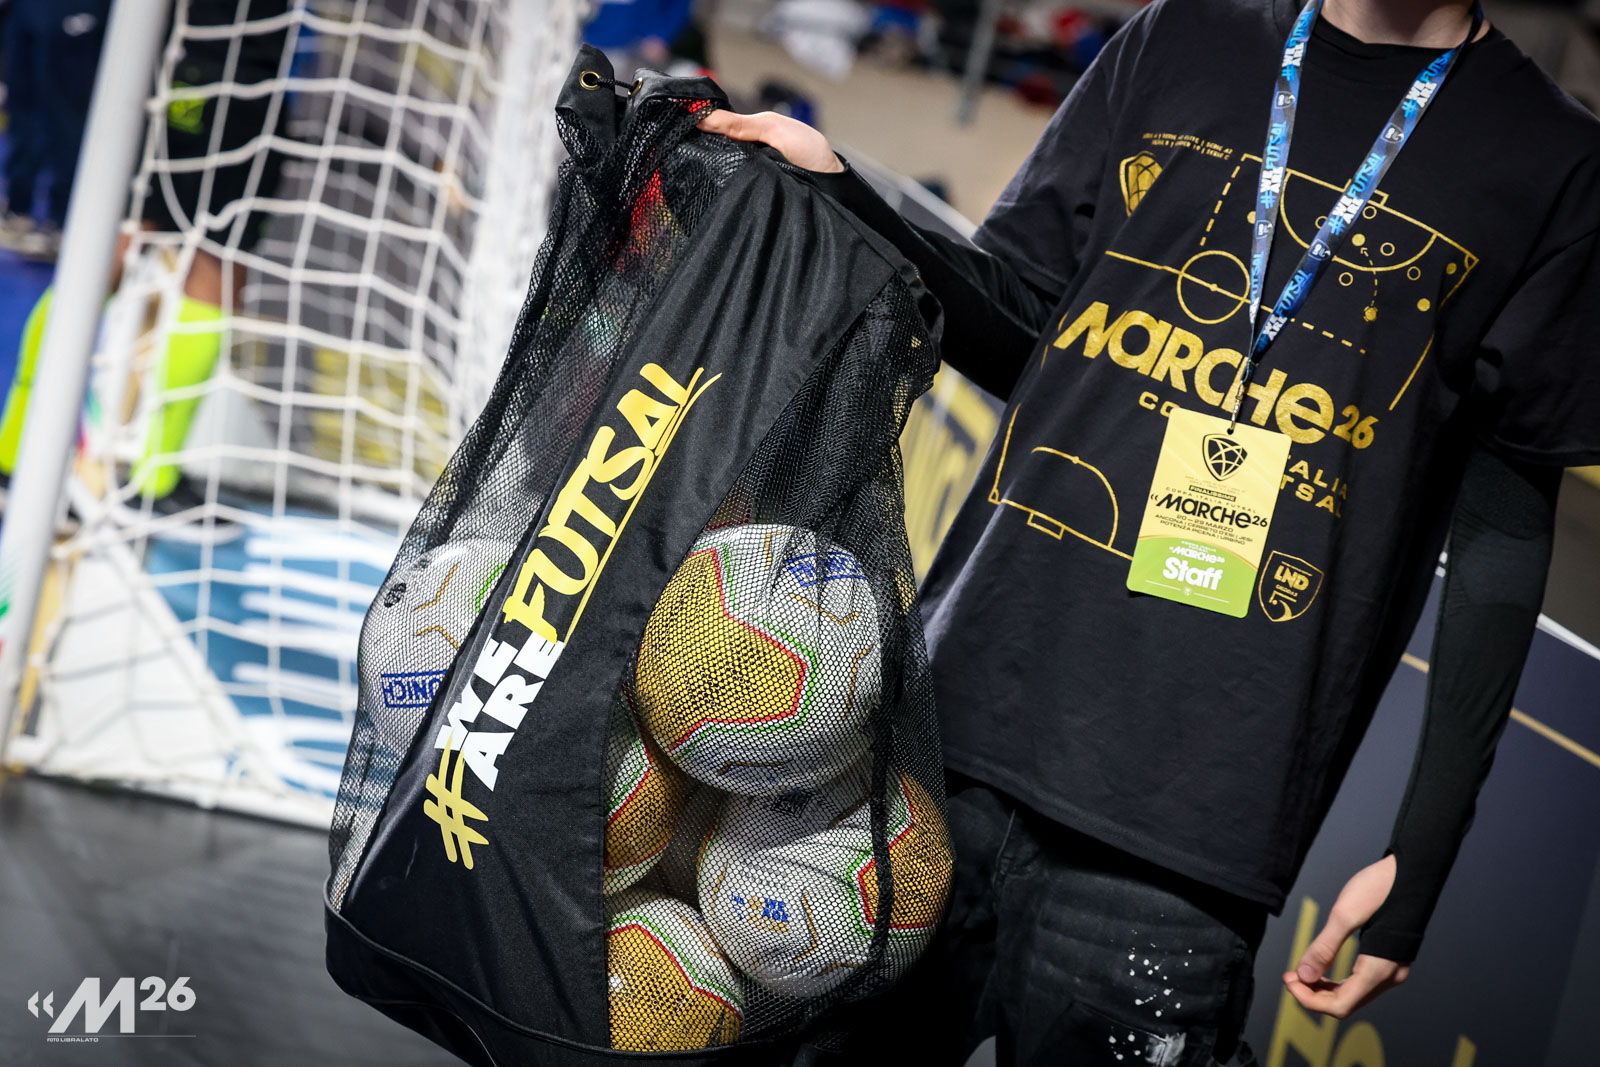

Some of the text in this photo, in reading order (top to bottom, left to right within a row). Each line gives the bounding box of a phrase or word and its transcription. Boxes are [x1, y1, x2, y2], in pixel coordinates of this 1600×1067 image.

[1347, 152, 1386, 200] FUTSAL
[1276, 269, 1312, 317] FUTSAL
[1280, 474, 1341, 518] TSAL
[1287, 454, 1347, 500] ALIA
[502, 363, 706, 644] FUTSAL
[1155, 514, 1184, 525] ANCONA
[1160, 520, 1191, 531] POTENZA
[1205, 521, 1234, 533] MARZO
[1162, 556, 1224, 591] Staff
[1273, 564, 1310, 591] LND
[382, 677, 442, 701] UNICH
[463, 631, 565, 792] ARE
